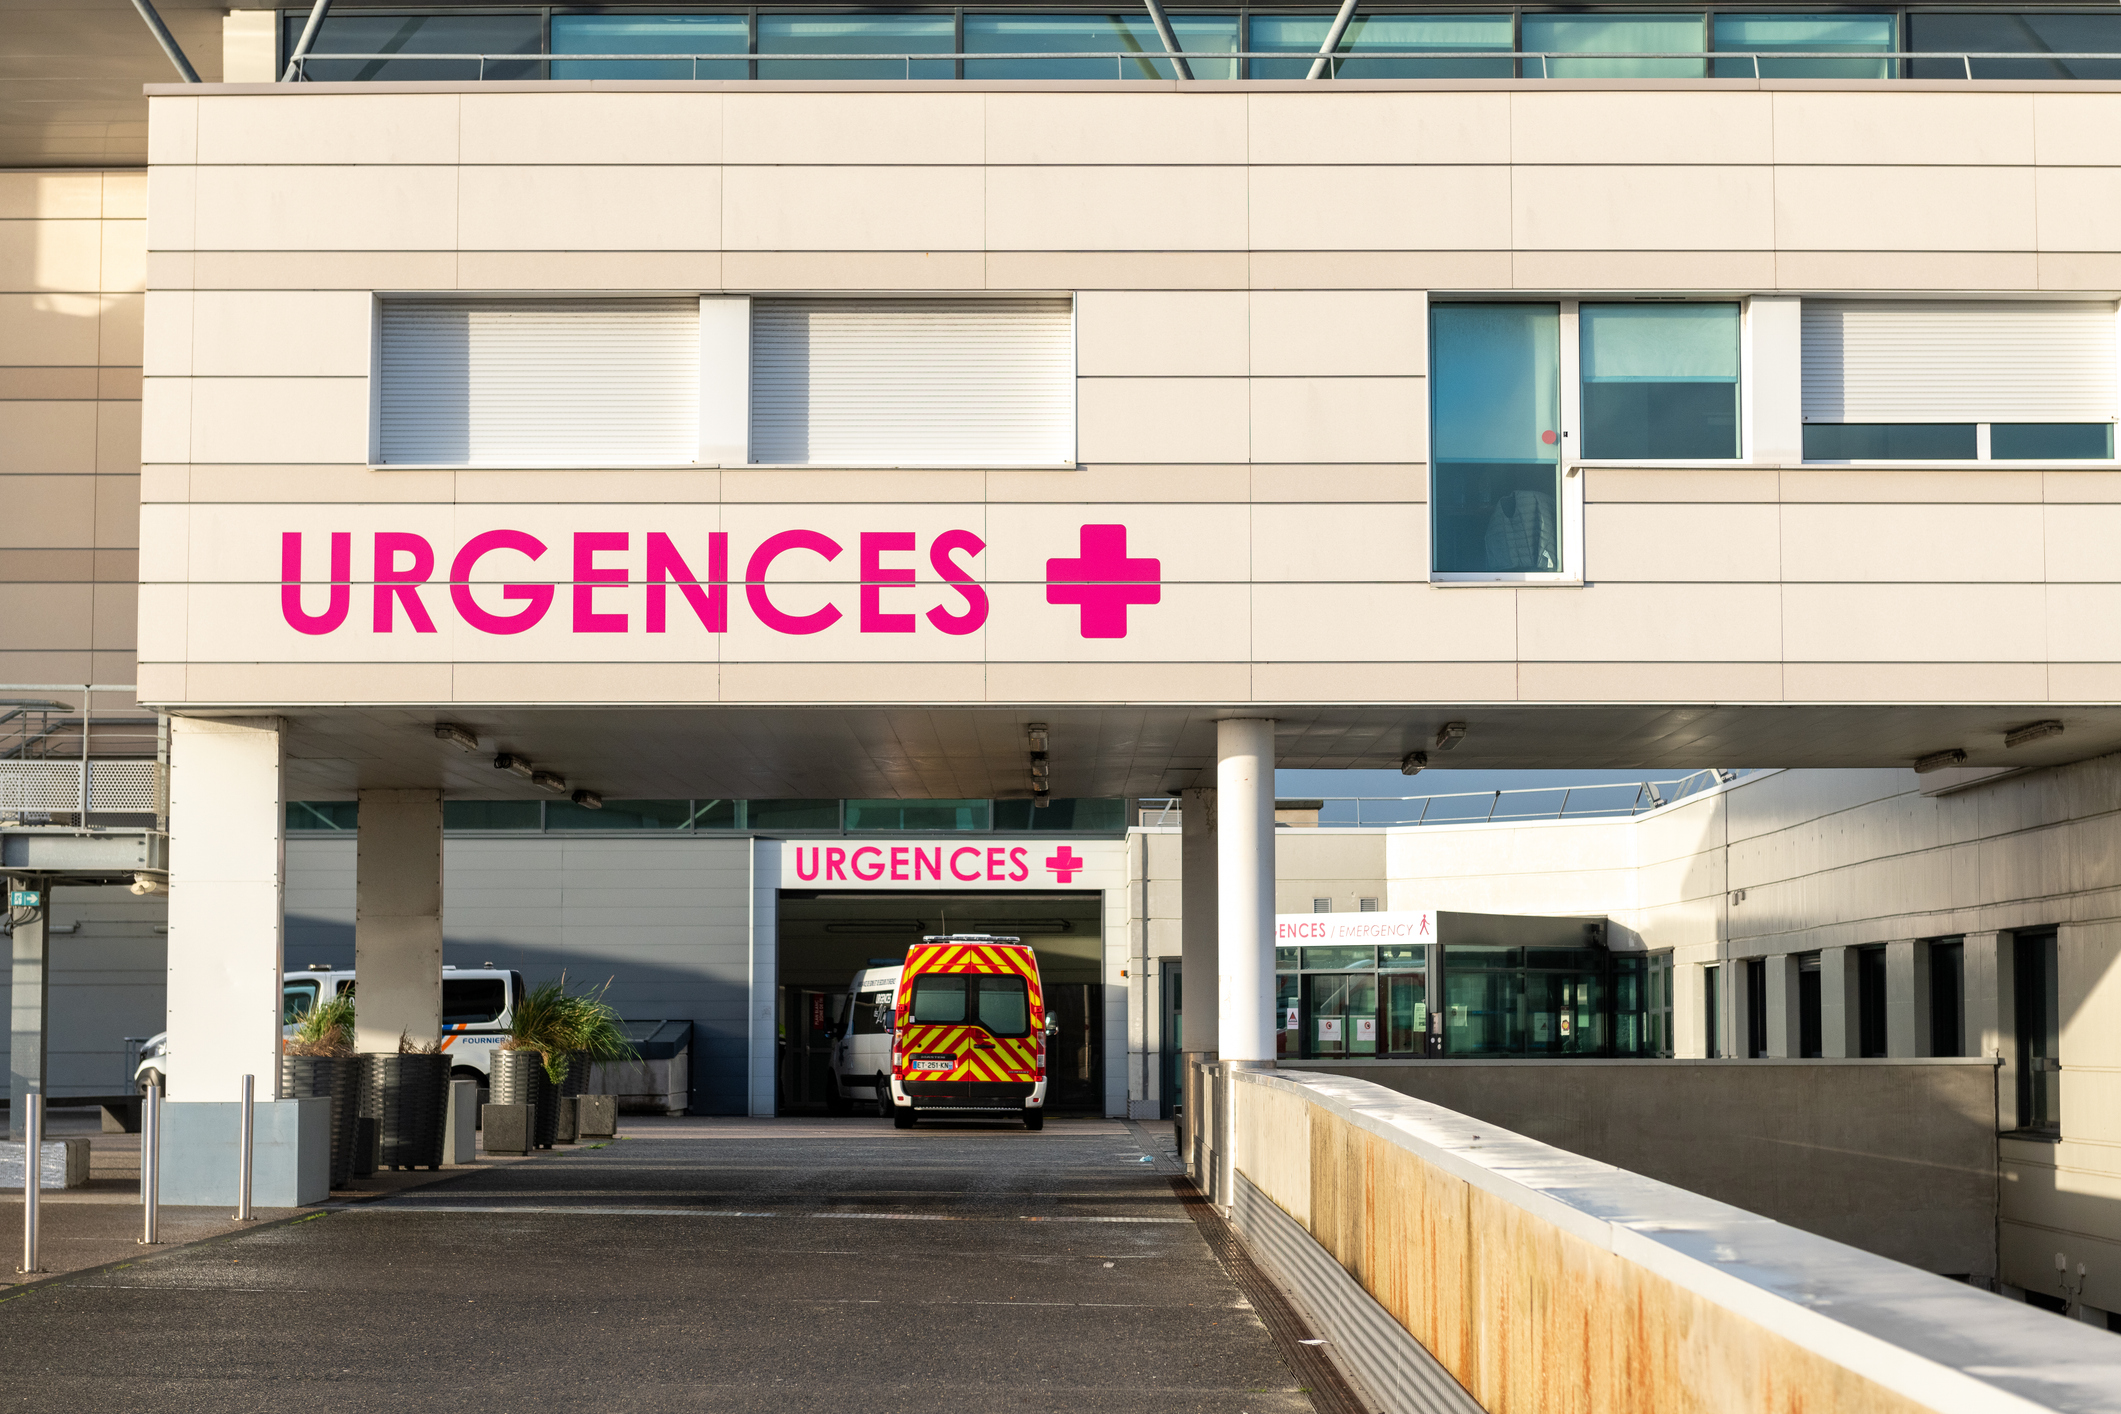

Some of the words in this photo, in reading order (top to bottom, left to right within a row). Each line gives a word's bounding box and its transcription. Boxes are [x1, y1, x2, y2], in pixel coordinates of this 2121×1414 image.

[282, 529, 989, 635] URGENCES
[796, 846, 1029, 882] URGENCES
[1275, 922, 1326, 938] ENCES
[1339, 924, 1414, 938] EMERGENCY
